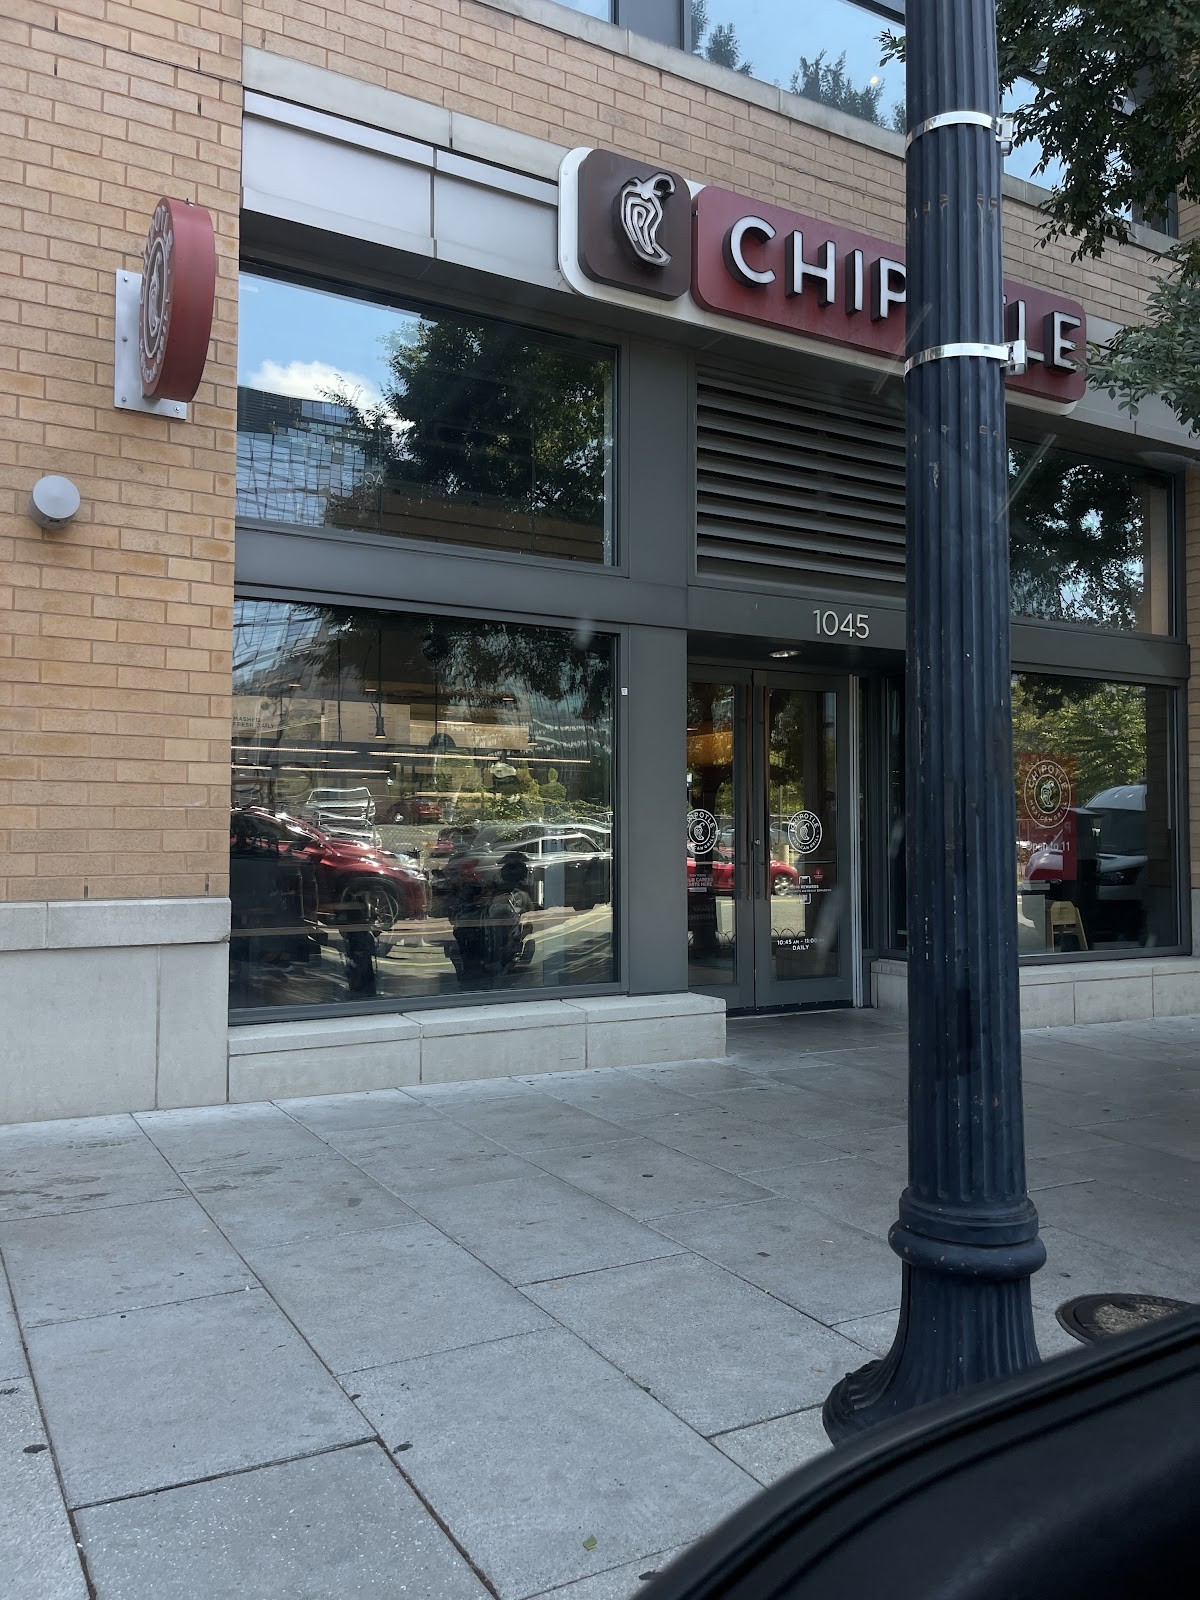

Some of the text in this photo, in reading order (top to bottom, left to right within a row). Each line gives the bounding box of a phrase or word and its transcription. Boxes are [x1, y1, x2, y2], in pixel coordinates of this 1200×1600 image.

[722, 214, 1082, 375] CHIPLE
[813, 609, 869, 639] 1045
[1028, 765, 1068, 789] CHIPOTLE
[1026, 840, 1070, 853] Open to 11
